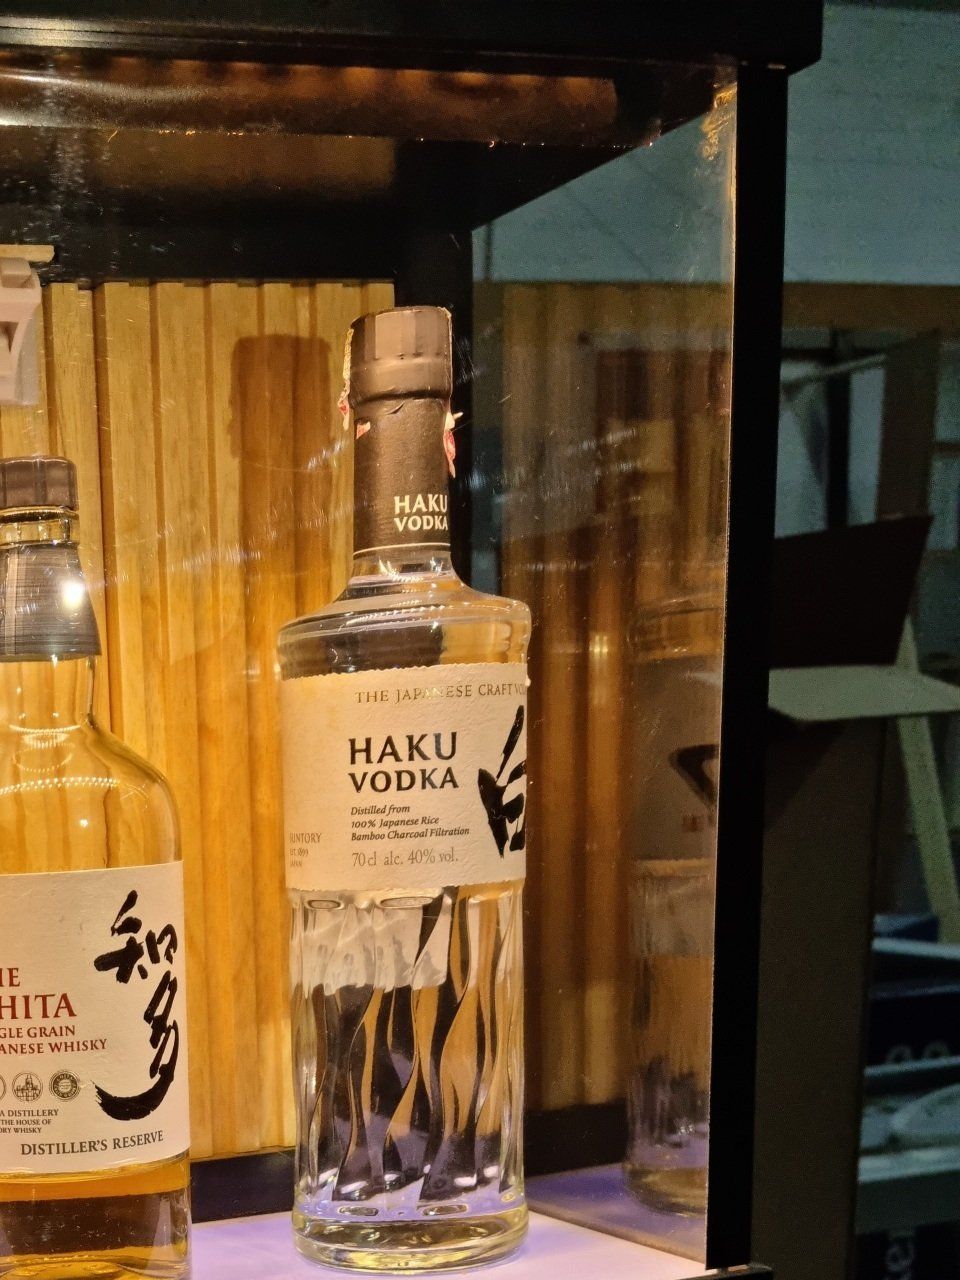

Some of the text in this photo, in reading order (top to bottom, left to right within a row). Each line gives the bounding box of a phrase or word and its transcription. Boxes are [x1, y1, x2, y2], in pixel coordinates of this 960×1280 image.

[394, 494, 448, 515] HAKU
[394, 515, 448, 532] VODKA
[355, 689, 389, 704] THE
[396, 685, 472, 703] JAPANESE
[478, 683, 513, 697] CRAFT
[348, 731, 458, 765] HAKU
[348, 766, 459, 793] VODKA
[351, 804, 410, 816] Distilled from
[351, 816, 440, 829] 100% Japanese Rice
[351, 826, 470, 841] Bamboo Charcoal Filtration
[383, 854, 403, 867] alc.
[407, 849, 436, 865] 40%
[439, 847, 459, 863] vol.
[27, 1025, 76, 1038] GRAIN
[48, 1039, 108, 1053] WHISKY
[7, 1107, 60, 1118] DISTILLERY
[1, 1118, 15, 1127] THE
[16, 1118, 41, 1127] HOUSE
[42, 1117, 52, 1126] OF
[13, 1126, 43, 1135] WHISKY
[21, 1130, 164, 1155] DISTILLER'S RESERVE
